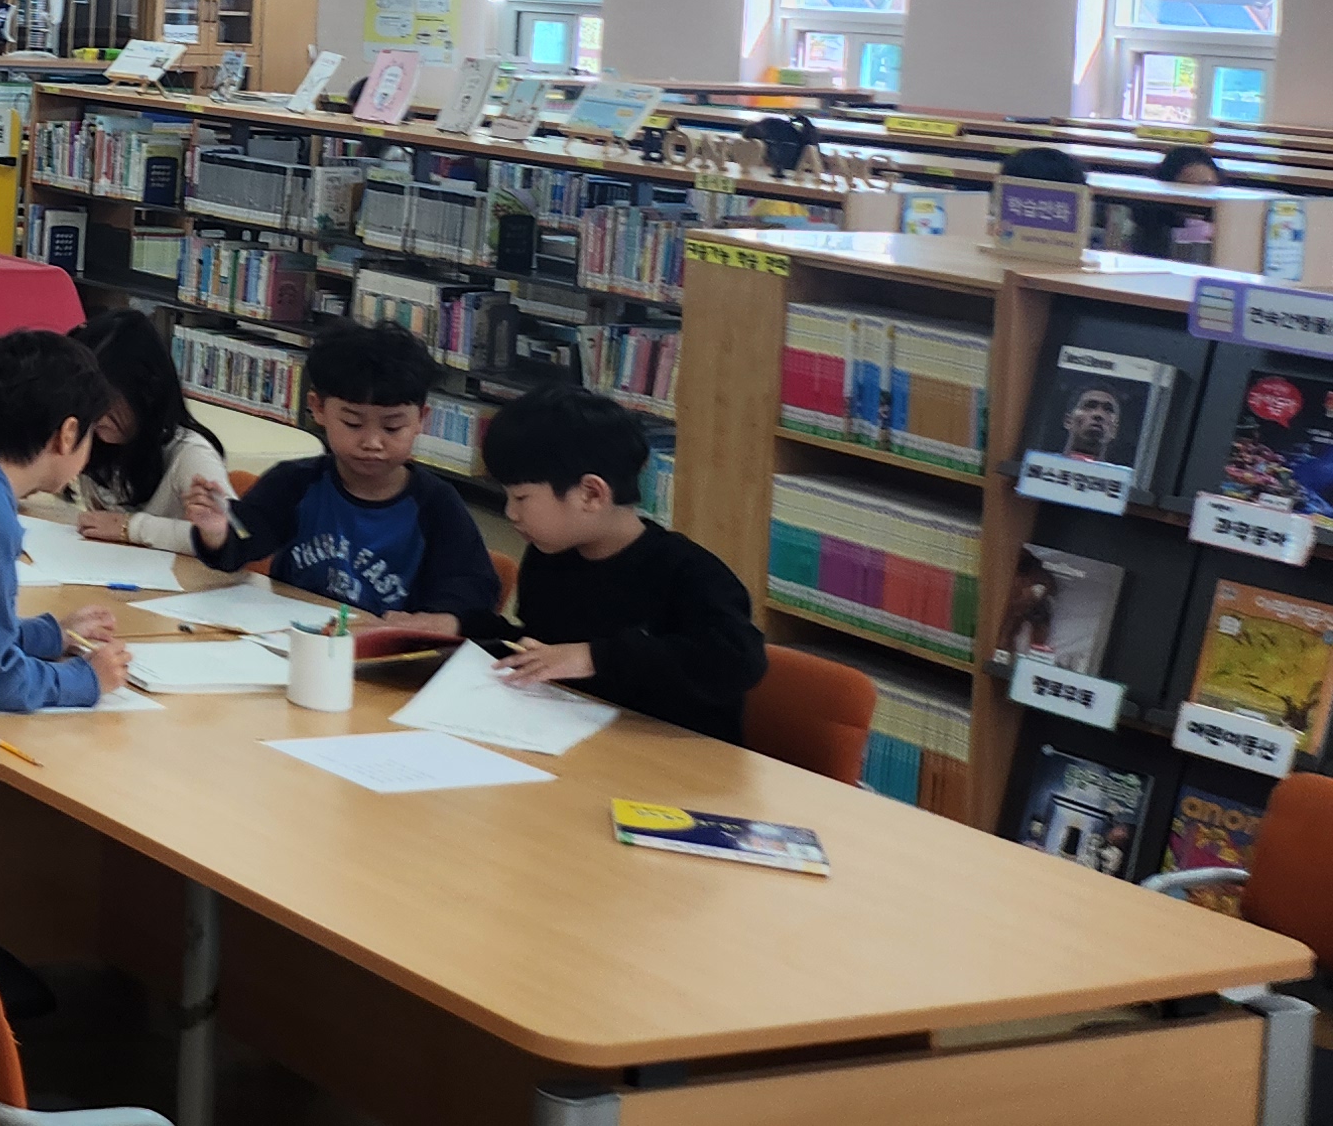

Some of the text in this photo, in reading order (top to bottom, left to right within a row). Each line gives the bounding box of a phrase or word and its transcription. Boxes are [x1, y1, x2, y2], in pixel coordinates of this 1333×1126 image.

[1027, 463, 1122, 499] 베스트일레븐
[1213, 516, 1288, 547] 과학동아
[353, 547, 410, 605] FAST
[1185, 719, 1282, 762] 어린이동산
